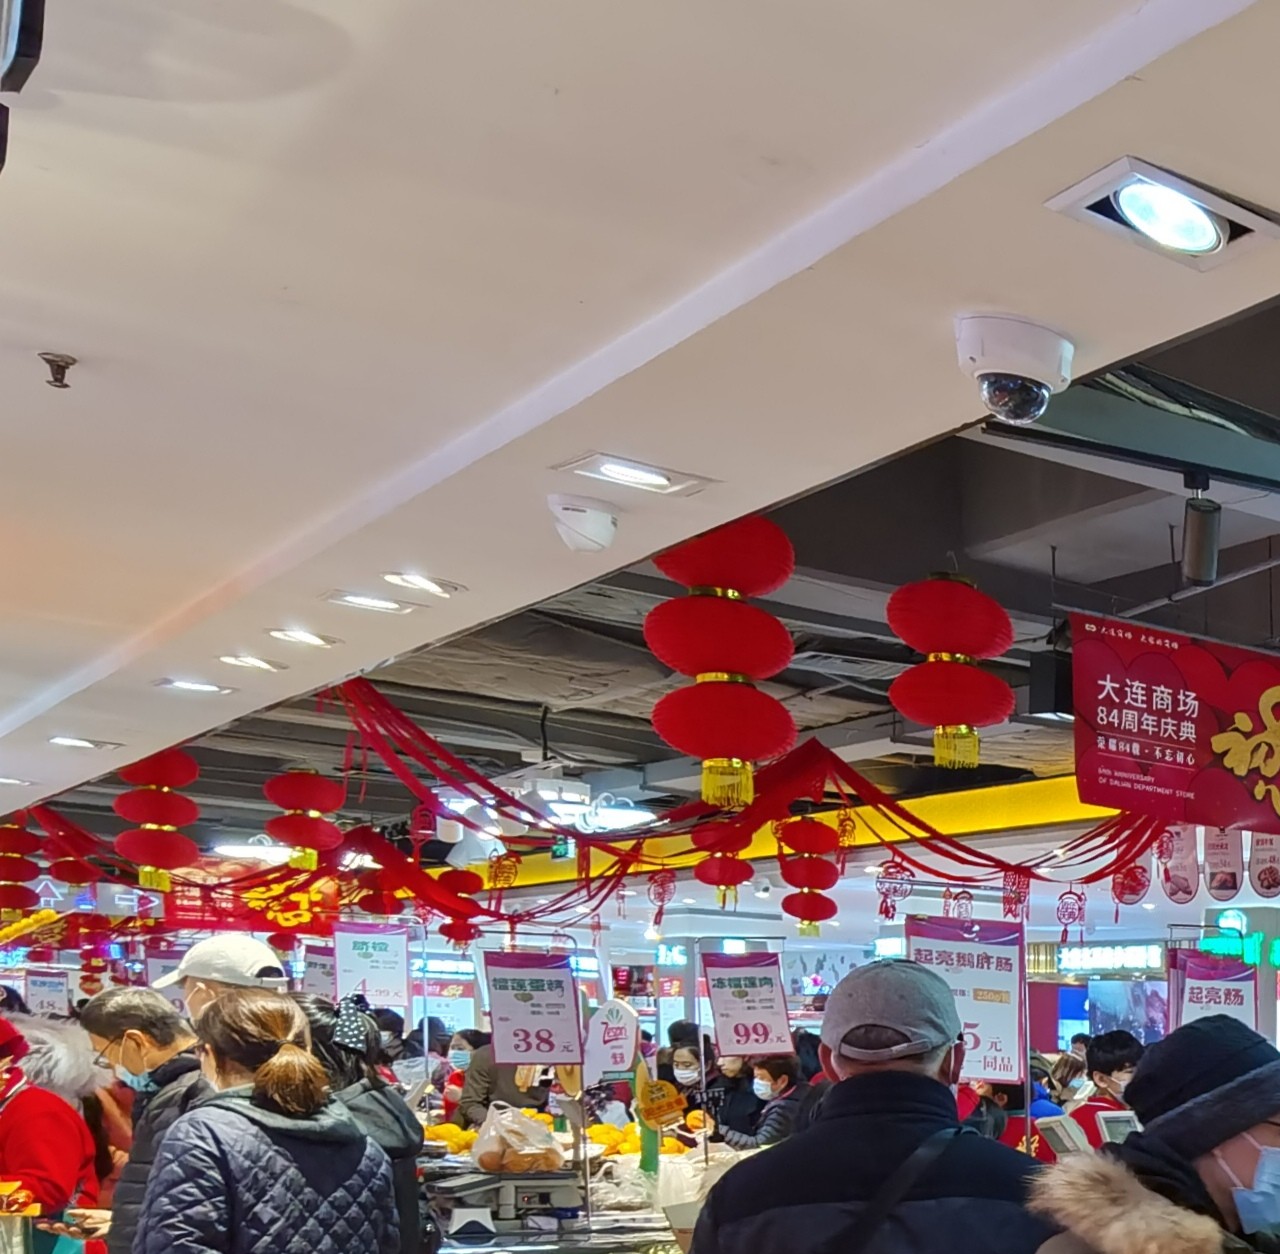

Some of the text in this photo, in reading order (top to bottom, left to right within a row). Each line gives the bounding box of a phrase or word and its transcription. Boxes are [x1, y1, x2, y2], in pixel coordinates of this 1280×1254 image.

[1097, 673, 1199, 718] 大连商场
[1097, 706, 1197, 743] 84周年庆典
[1188, 987, 1244, 1006] 起亮肠
[961, 1055, 1013, 1073] 一同品
